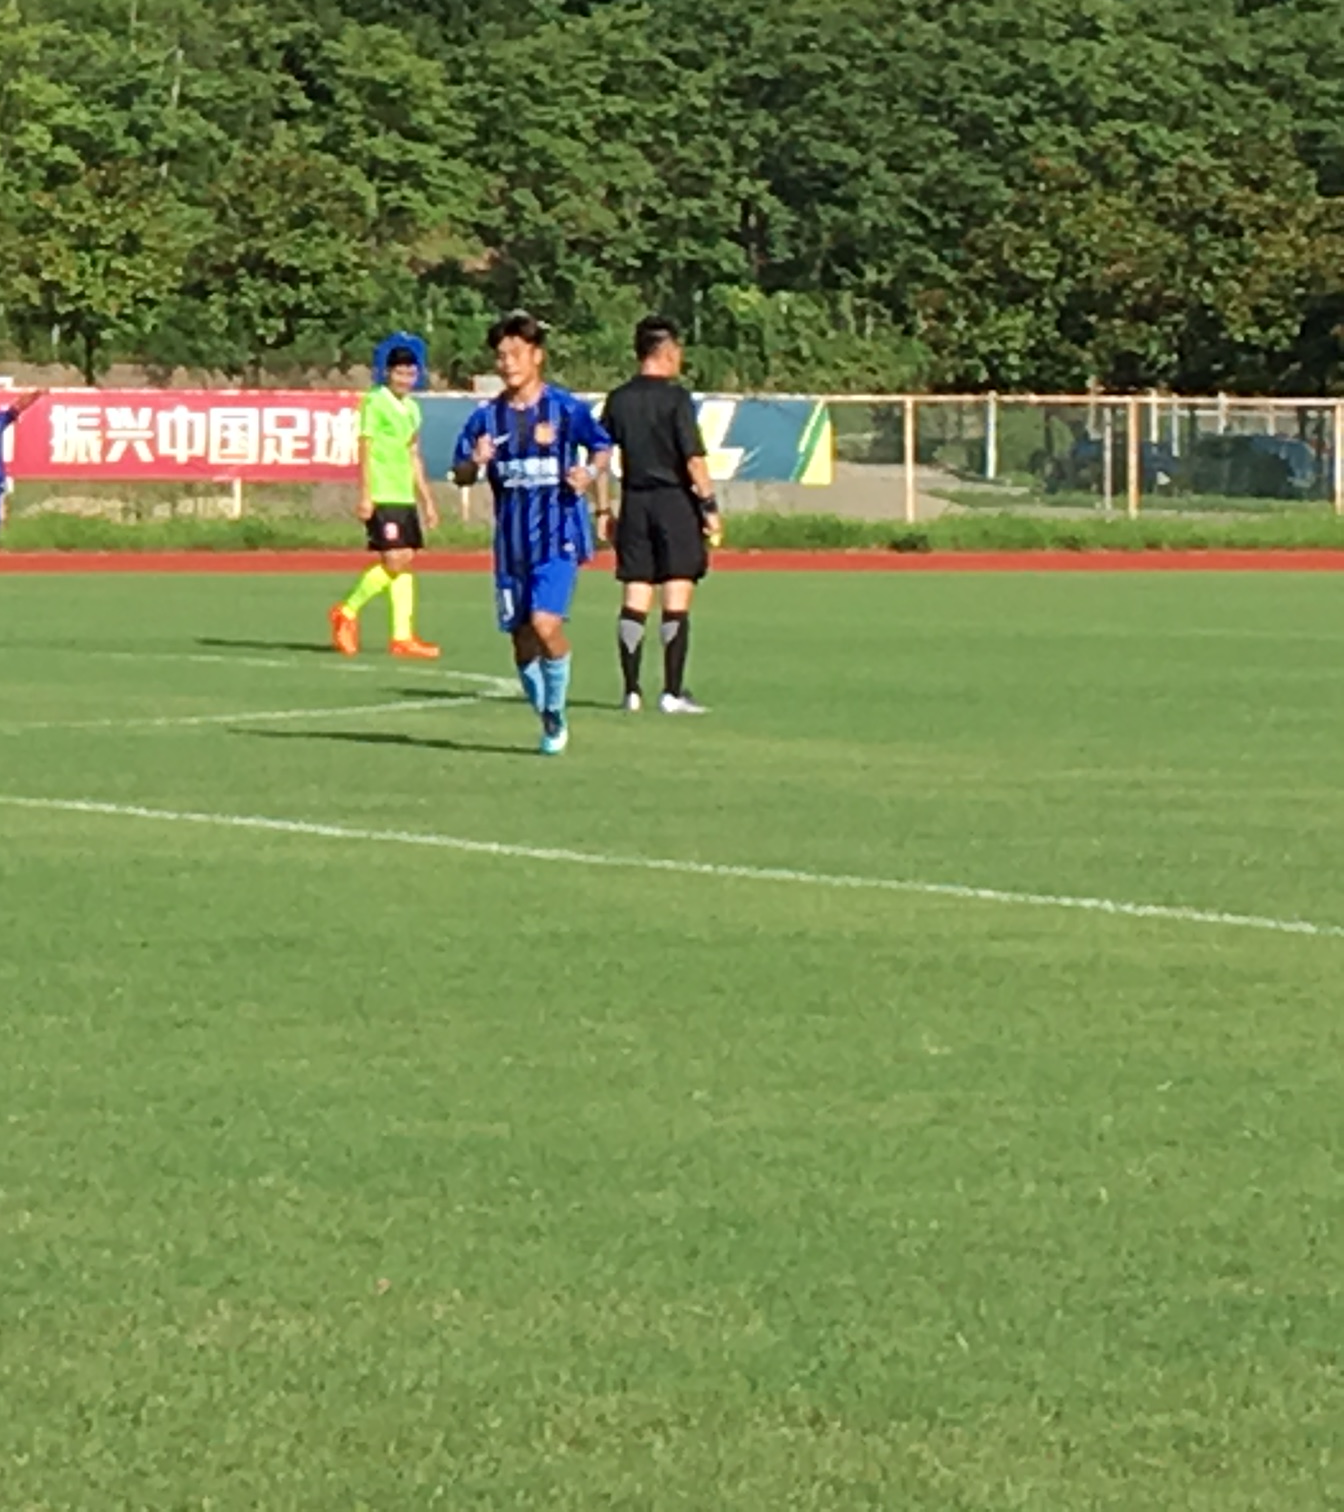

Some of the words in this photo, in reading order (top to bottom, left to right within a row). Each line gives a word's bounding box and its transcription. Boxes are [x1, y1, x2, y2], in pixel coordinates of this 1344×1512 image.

[49, 404, 360, 466] 振兴中国足球
